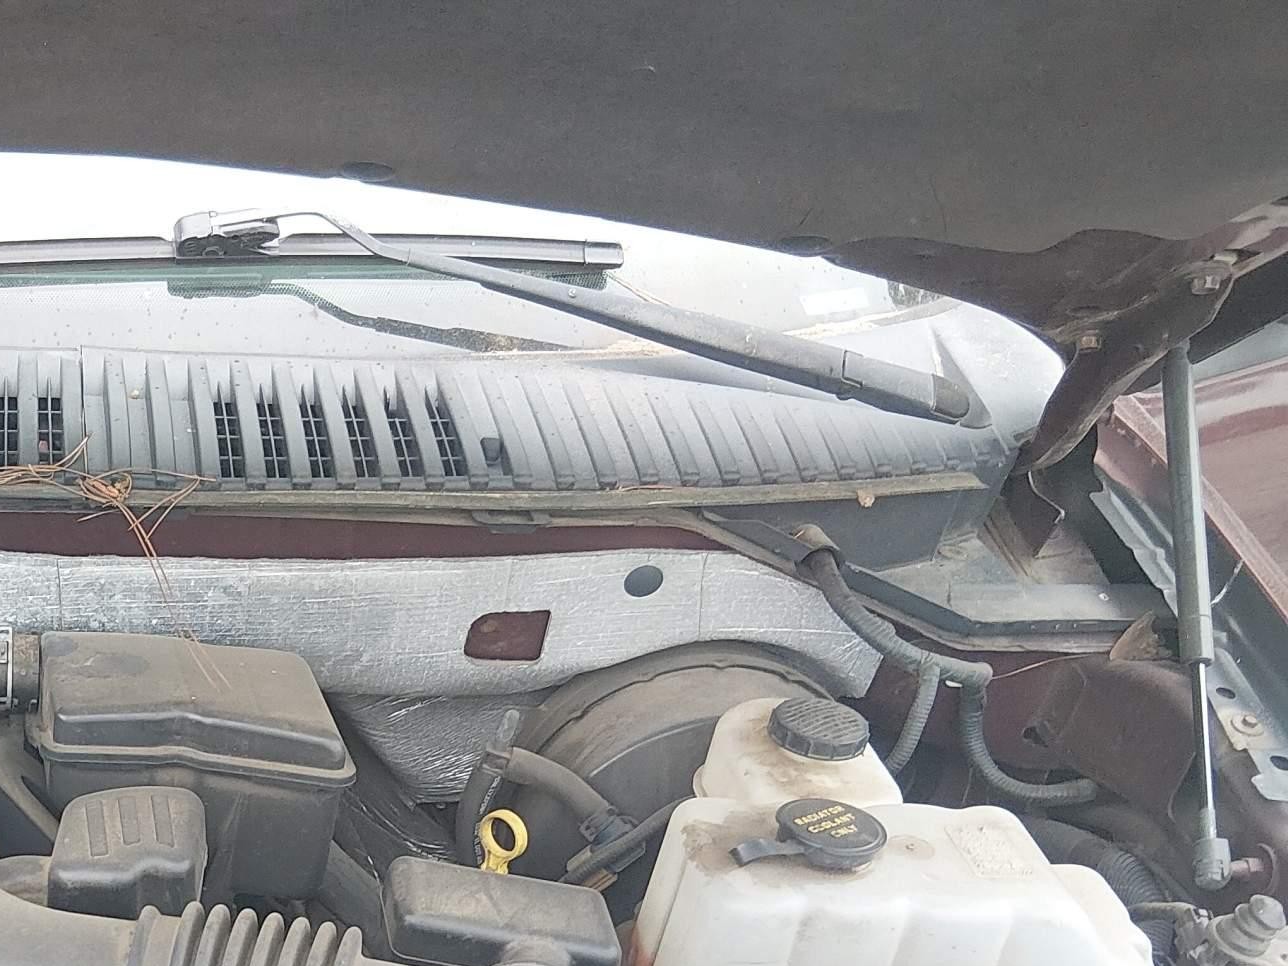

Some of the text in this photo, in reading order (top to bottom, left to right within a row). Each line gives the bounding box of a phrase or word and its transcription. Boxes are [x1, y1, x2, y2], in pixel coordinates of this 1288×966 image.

[793, 805, 845, 825] RADIATOR
[808, 813, 855, 833] COOLANT
[831, 824, 858, 837] ONLY
